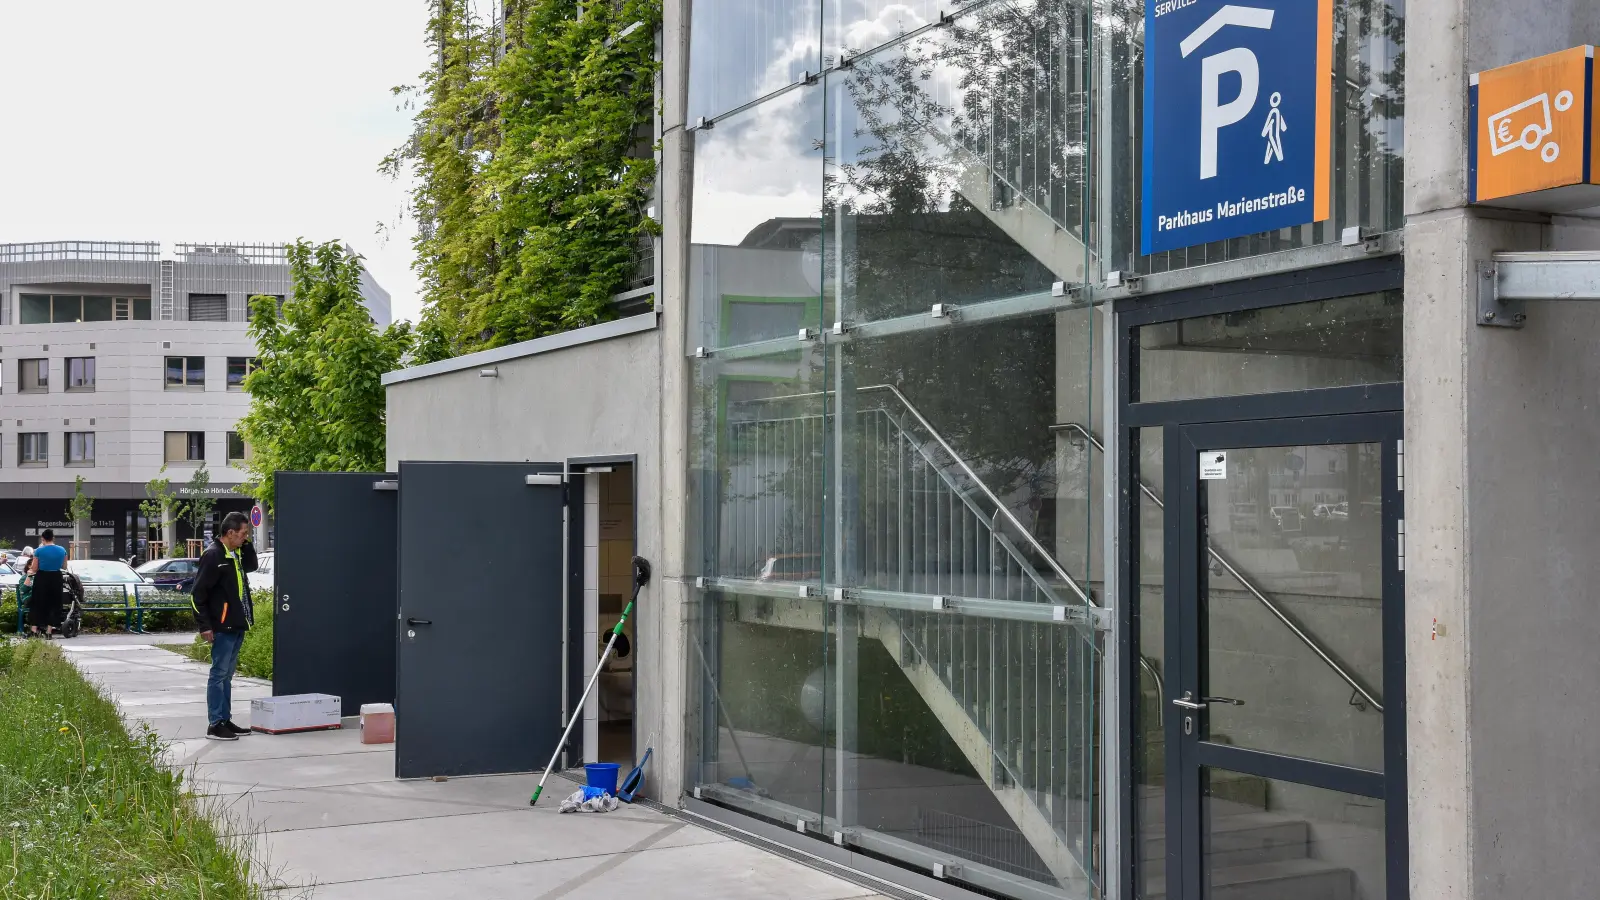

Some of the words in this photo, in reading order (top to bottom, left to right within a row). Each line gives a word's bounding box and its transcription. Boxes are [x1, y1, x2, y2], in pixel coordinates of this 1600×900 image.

[1158, 208, 1213, 232] Parkhaus
[1217, 185, 1305, 219] Marienstraße
[37, 520, 74, 528] Regensburge
